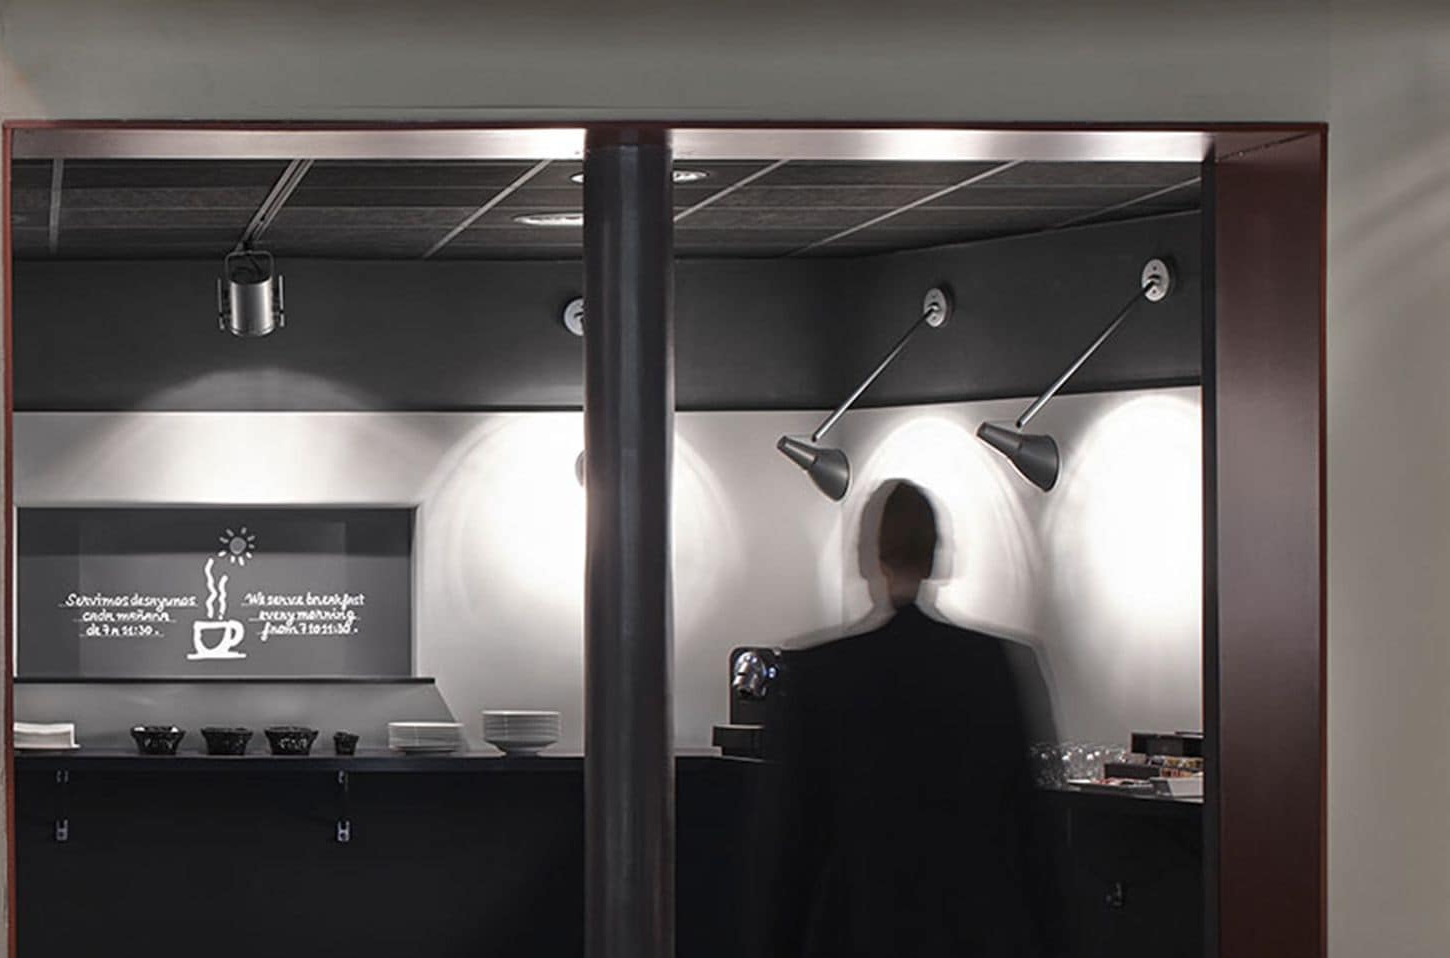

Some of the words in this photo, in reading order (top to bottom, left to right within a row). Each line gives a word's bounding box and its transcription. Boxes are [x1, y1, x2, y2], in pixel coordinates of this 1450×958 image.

[65, 593, 125, 606] Servimos
[125, 592, 197, 613] desayunos
[244, 591, 265, 605] We
[266, 595, 304, 605] serve
[305, 591, 365, 610] breakfast
[81, 608, 116, 622] cada
[258, 609, 296, 626] every
[260, 622, 298, 641] from
